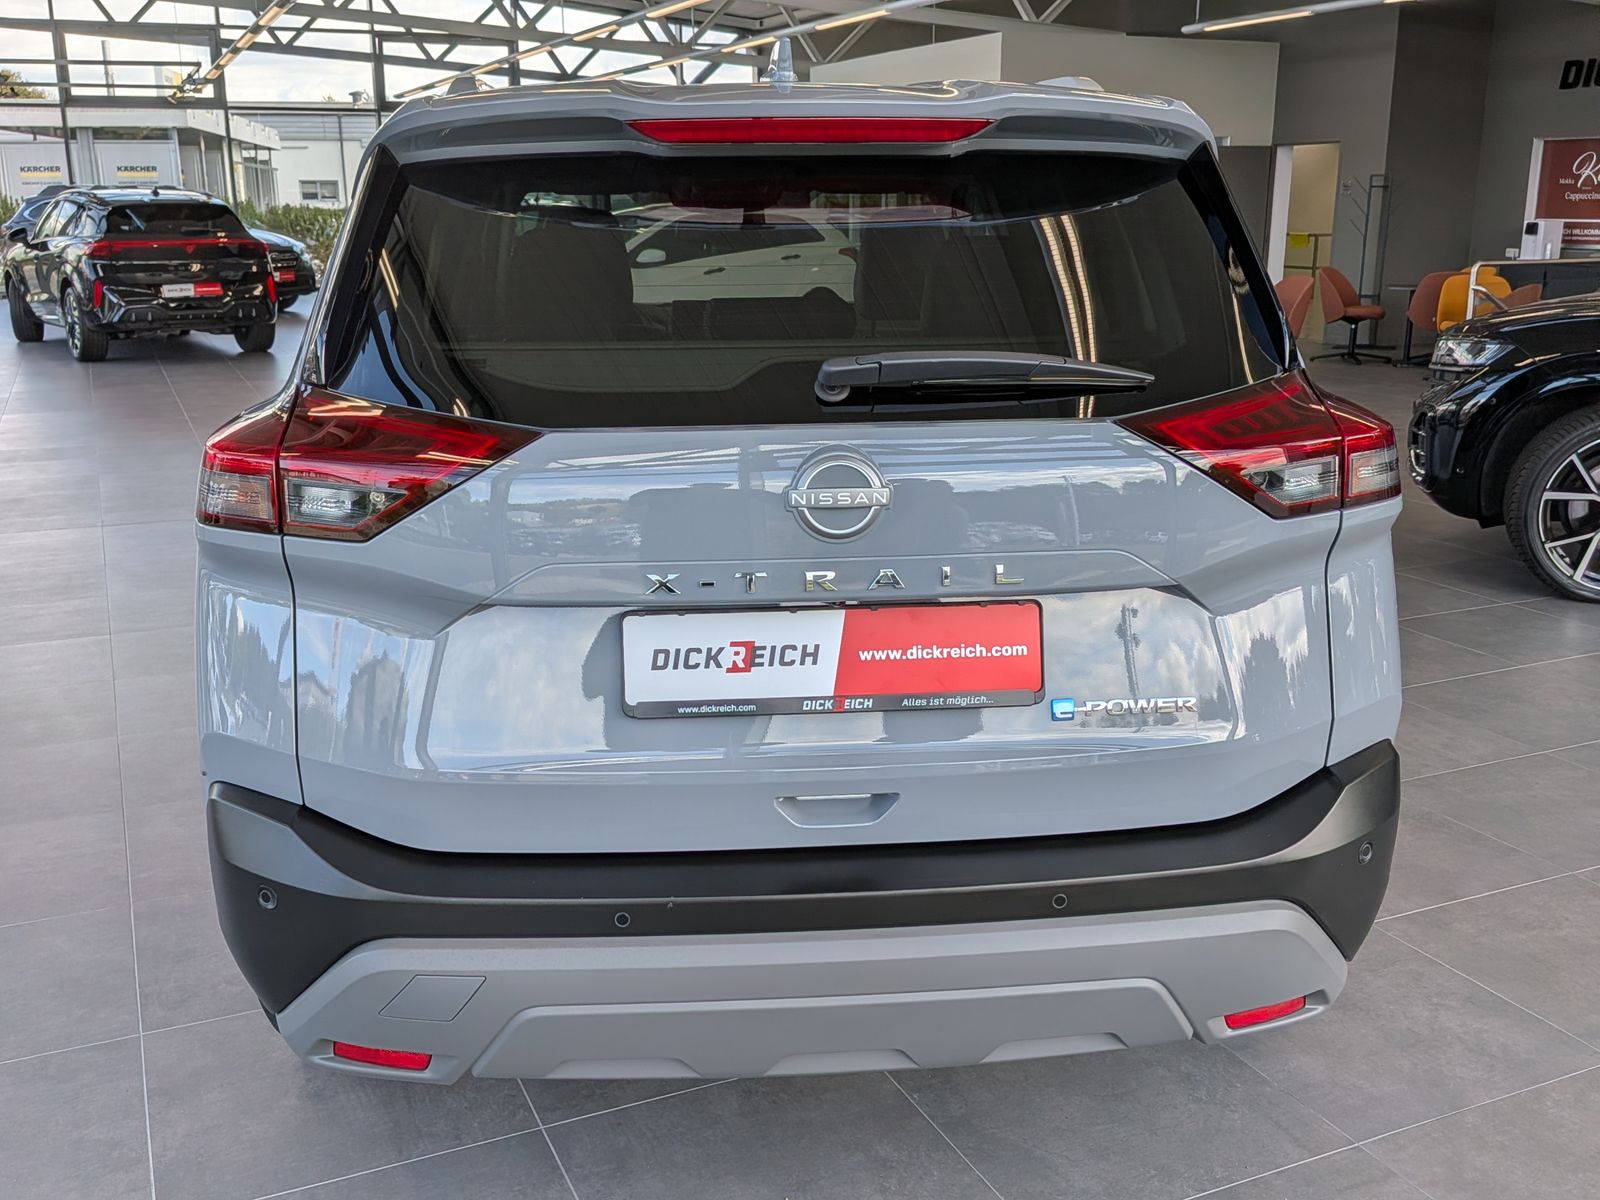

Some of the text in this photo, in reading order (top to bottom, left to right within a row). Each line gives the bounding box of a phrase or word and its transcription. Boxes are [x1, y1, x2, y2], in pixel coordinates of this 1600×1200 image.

[791, 492, 887, 505] NISSAN
[645, 563, 1025, 595] X-TRAIL
[651, 641, 820, 672] DICKREICH
[858, 643, 1028, 661] www.dickreich.com
[677, 703, 757, 714] www.dickreich.com
[902, 695, 995, 707] Alles ist möglich...
